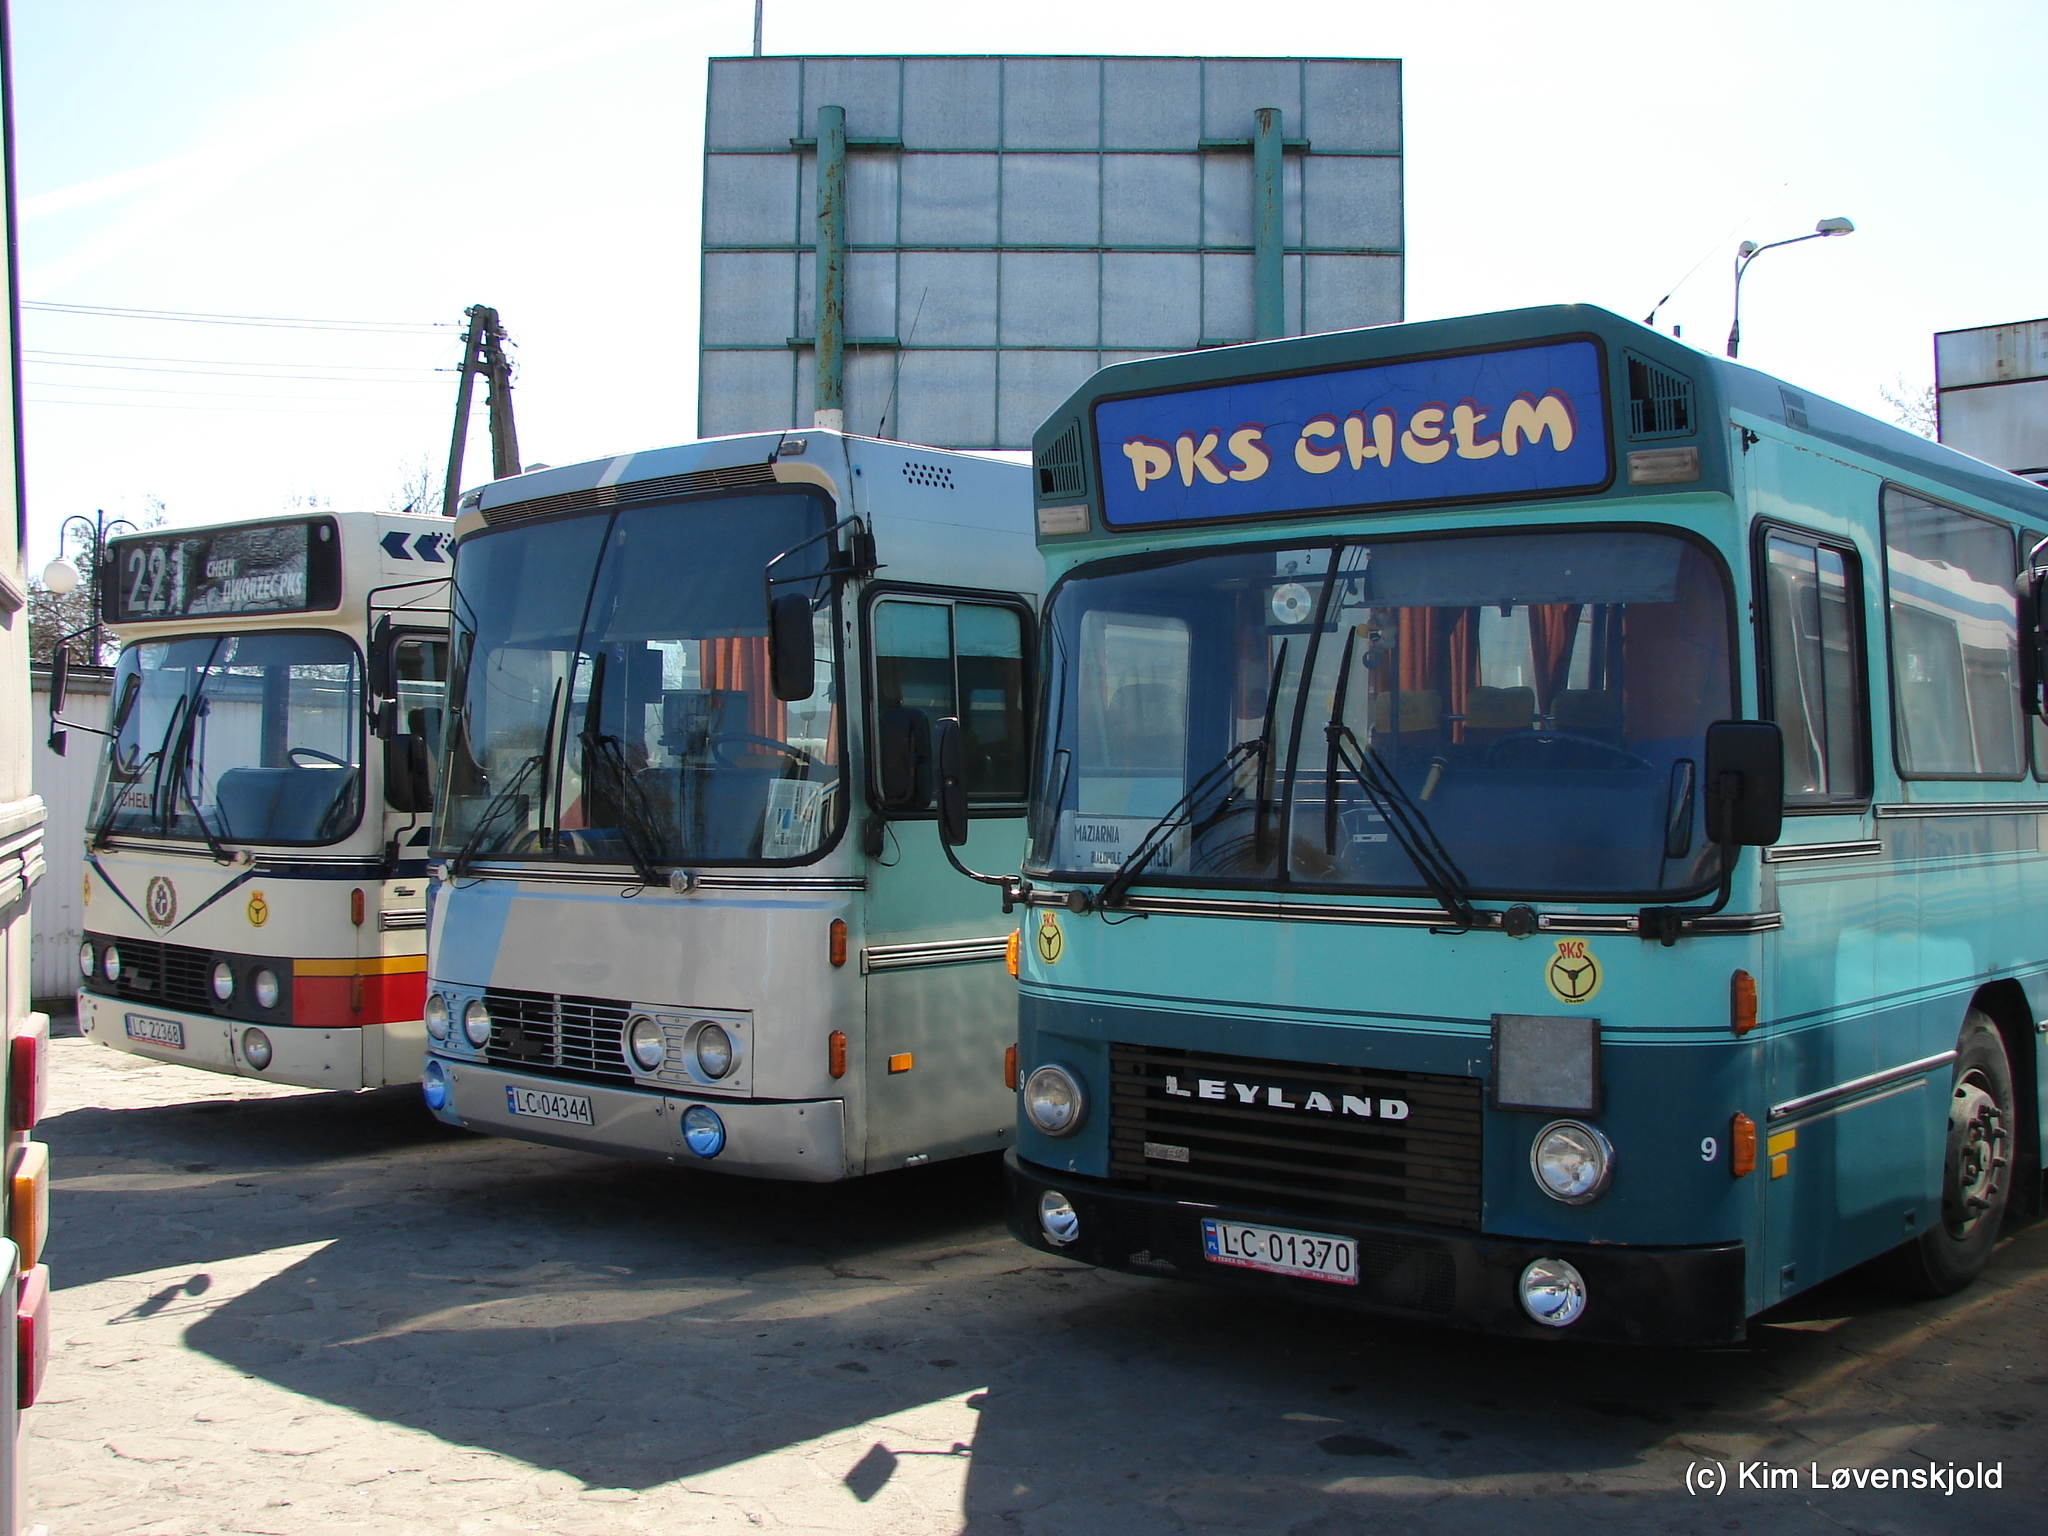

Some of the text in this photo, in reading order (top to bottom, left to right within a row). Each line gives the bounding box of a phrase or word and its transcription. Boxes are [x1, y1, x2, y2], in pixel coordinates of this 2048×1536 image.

[1122, 388, 1577, 492] PKS CHEŁM
[1305, 554, 1311, 565] 2
[127, 543, 185, 613] 221
[223, 571, 304, 602] DWORZEC PKS
[1074, 824, 1120, 844] MAZIARNIA
[1558, 941, 1585, 960] PKS
[132, 1017, 148, 1037] LC
[149, 1020, 180, 1043] 22368
[516, 1090, 589, 1122] LC 04344
[1165, 1075, 1410, 1121] LEYLAND
[1700, 1136, 1718, 1162] 9
[1208, 1241, 1218, 1250] PL
[1222, 1226, 1258, 1258] LC
[1268, 1233, 1350, 1273] 01370
